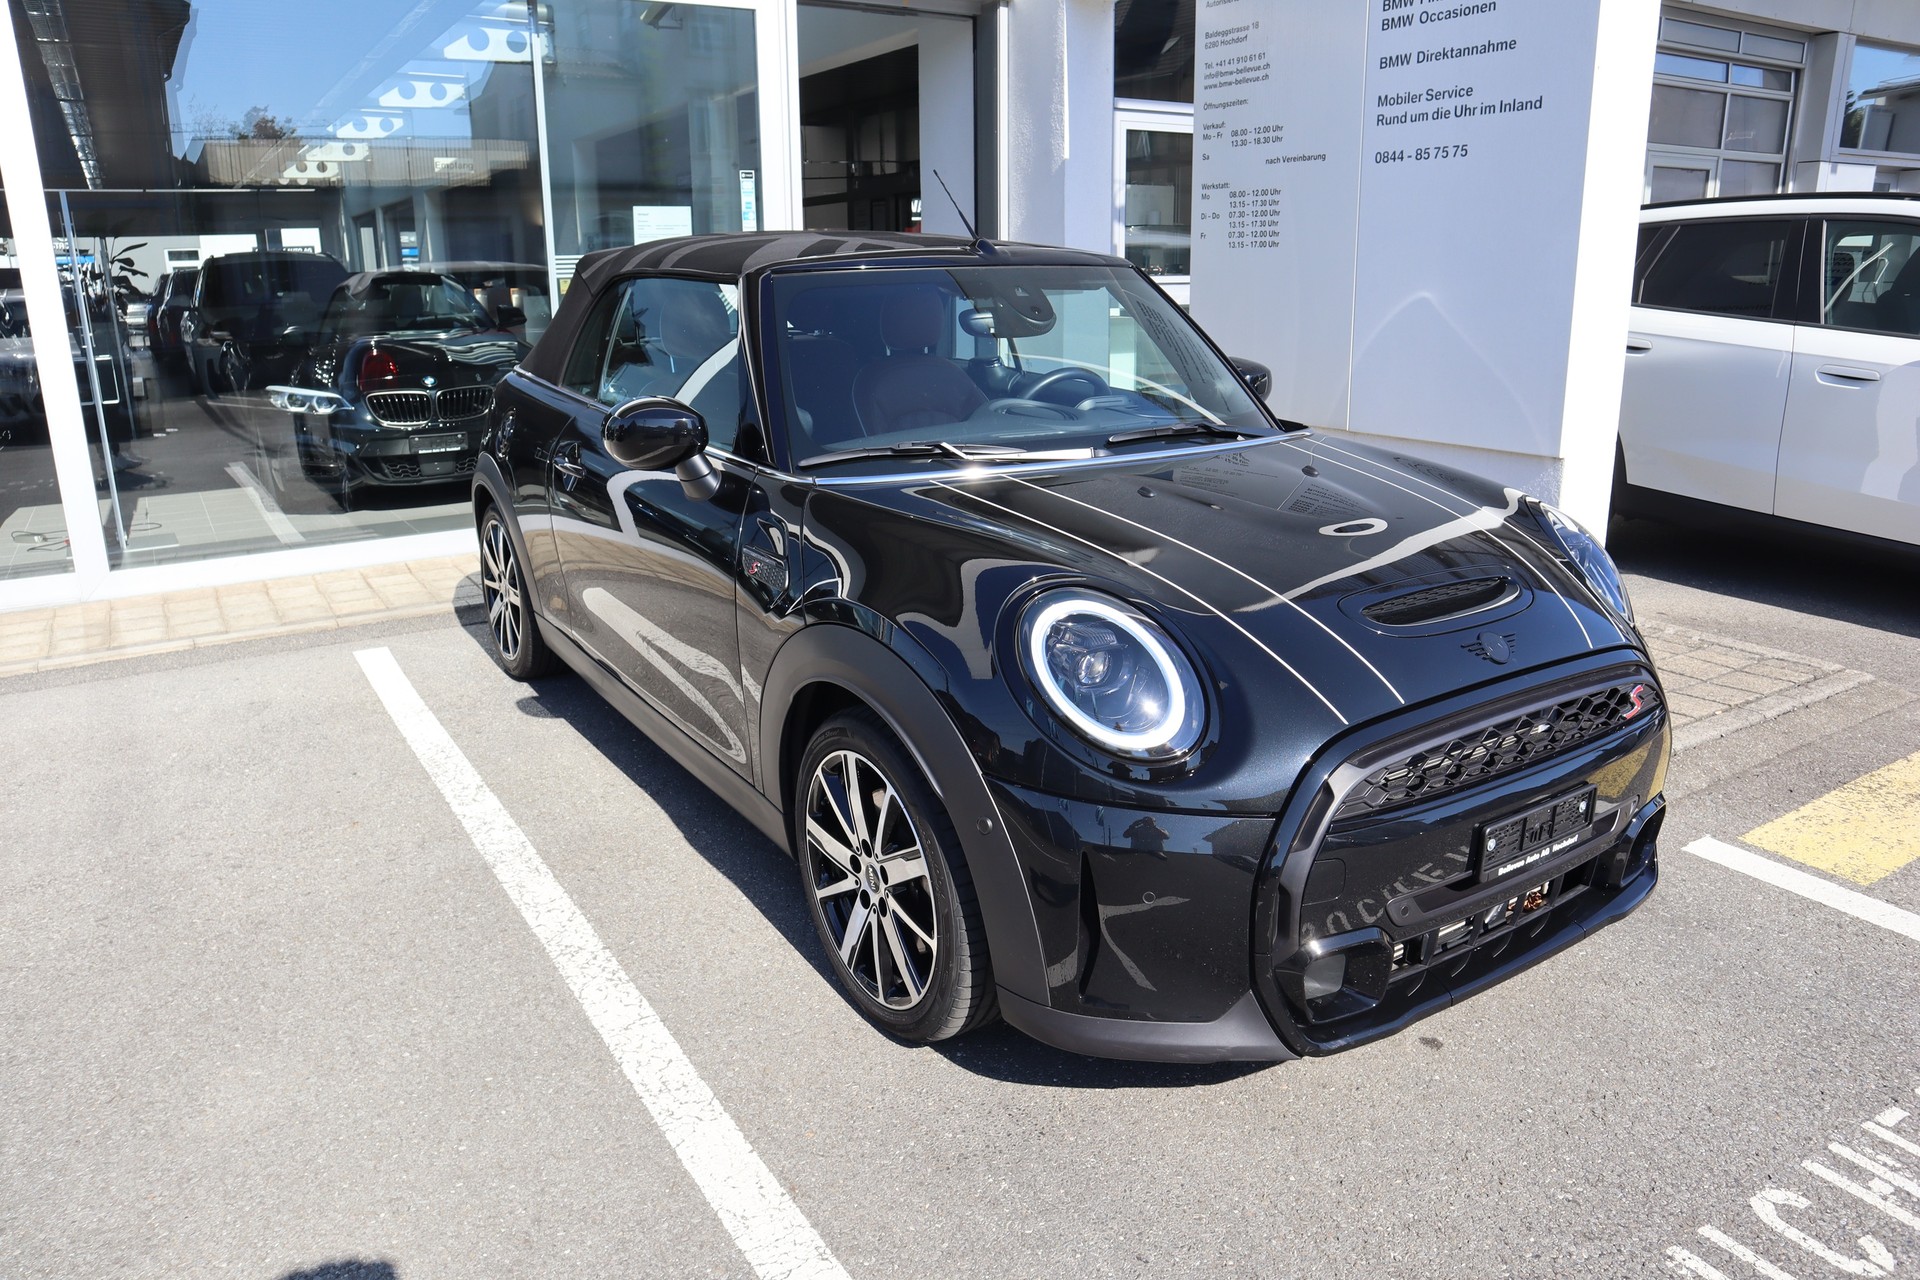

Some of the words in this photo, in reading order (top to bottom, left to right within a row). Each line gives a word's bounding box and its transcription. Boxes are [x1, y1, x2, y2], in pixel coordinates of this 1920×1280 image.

[1381, 13, 1414, 31] BMW
[1419, 1, 1497, 25] Occasionen
[1205, 24, 1250, 39] Baldeggstrasse
[1252, 21, 1259, 30] 18
[1204, 40, 1220, 50] 6280
[1220, 34, 1248, 47] Hochdorf
[1204, 62, 1214, 70] Tel.
[1215, 59, 1226, 67] +41
[1236, 55, 1248, 64] 910
[1249, 54, 1256, 62] 61
[1258, 52, 1266, 61] 61
[1379, 53, 1412, 70] BMW
[1416, 39, 1517, 64] Direktannahme
[1204, 62, 1271, 80] info@bmw-bellevue.ch
[1203, 73, 1270, 90] www.bmw-bellevue.ch
[1377, 91, 1423, 108] Mobiler
[1425, 85, 1474, 102] Service
[1376, 111, 1408, 127] Rund
[1410, 110, 1429, 123] um
[1431, 107, 1451, 121] die
[1454, 103, 1478, 118] Uhr
[1479, 102, 1496, 116] im
[1499, 95, 1543, 114] Inland
[1202, 133, 1211, 141] Mo
[1217, 131, 1223, 139] Fr
[1231, 128, 1248, 138] 08.00
[1254, 125, 1271, 135] 12.00
[1272, 124, 1284, 133] Uhr
[1231, 138, 1248, 147] 13.30
[1253, 136, 1271, 145] 18.30
[1271, 135, 1284, 143] Uhr
[1202, 153, 1210, 161] Sa
[1265, 157, 1281, 165] nach
[1282, 153, 1327, 164] Vereinbarung
[1374, 149, 1405, 164] 0844
[1415, 147, 1431, 161] 85
[1433, 146, 1449, 160] 75
[1452, 144, 1468, 158] 75
[1201, 182, 1231, 190] Werkstatt:
[1229, 190, 1246, 198] 08.00
[1252, 189, 1269, 197] 12.00
[1269, 188, 1281, 196] Uhr
[1229, 200, 1246, 208] 13.15
[1251, 199, 1268, 207] 17.30
[1268, 199, 1280, 207] Uhr
[1200, 212, 1207, 220] Di
[1211, 212, 1220, 220] Do
[1228, 210, 1246, 219] 07.30
[1251, 209, 1268, 217] 12.00
[1269, 209, 1281, 217] Uhr
[1229, 220, 1245, 229] 13.15
[1251, 220, 1267, 228] 17.30
[1267, 219, 1279, 227] Uhr
[1200, 232, 1207, 240] Fr
[1228, 231, 1245, 239] 07.30
[1250, 230, 1268, 238] 12.00
[1268, 230, 1280, 238] Uhr
[1228, 241, 1245, 249] 13.15
[1250, 240, 1268, 248] 17.00
[1268, 240, 1280, 248] Uhr
[1622, 684, 1644, 720] S
[1525, 853, 1540, 864] Auto
[1540, 847, 1550, 858] AG
